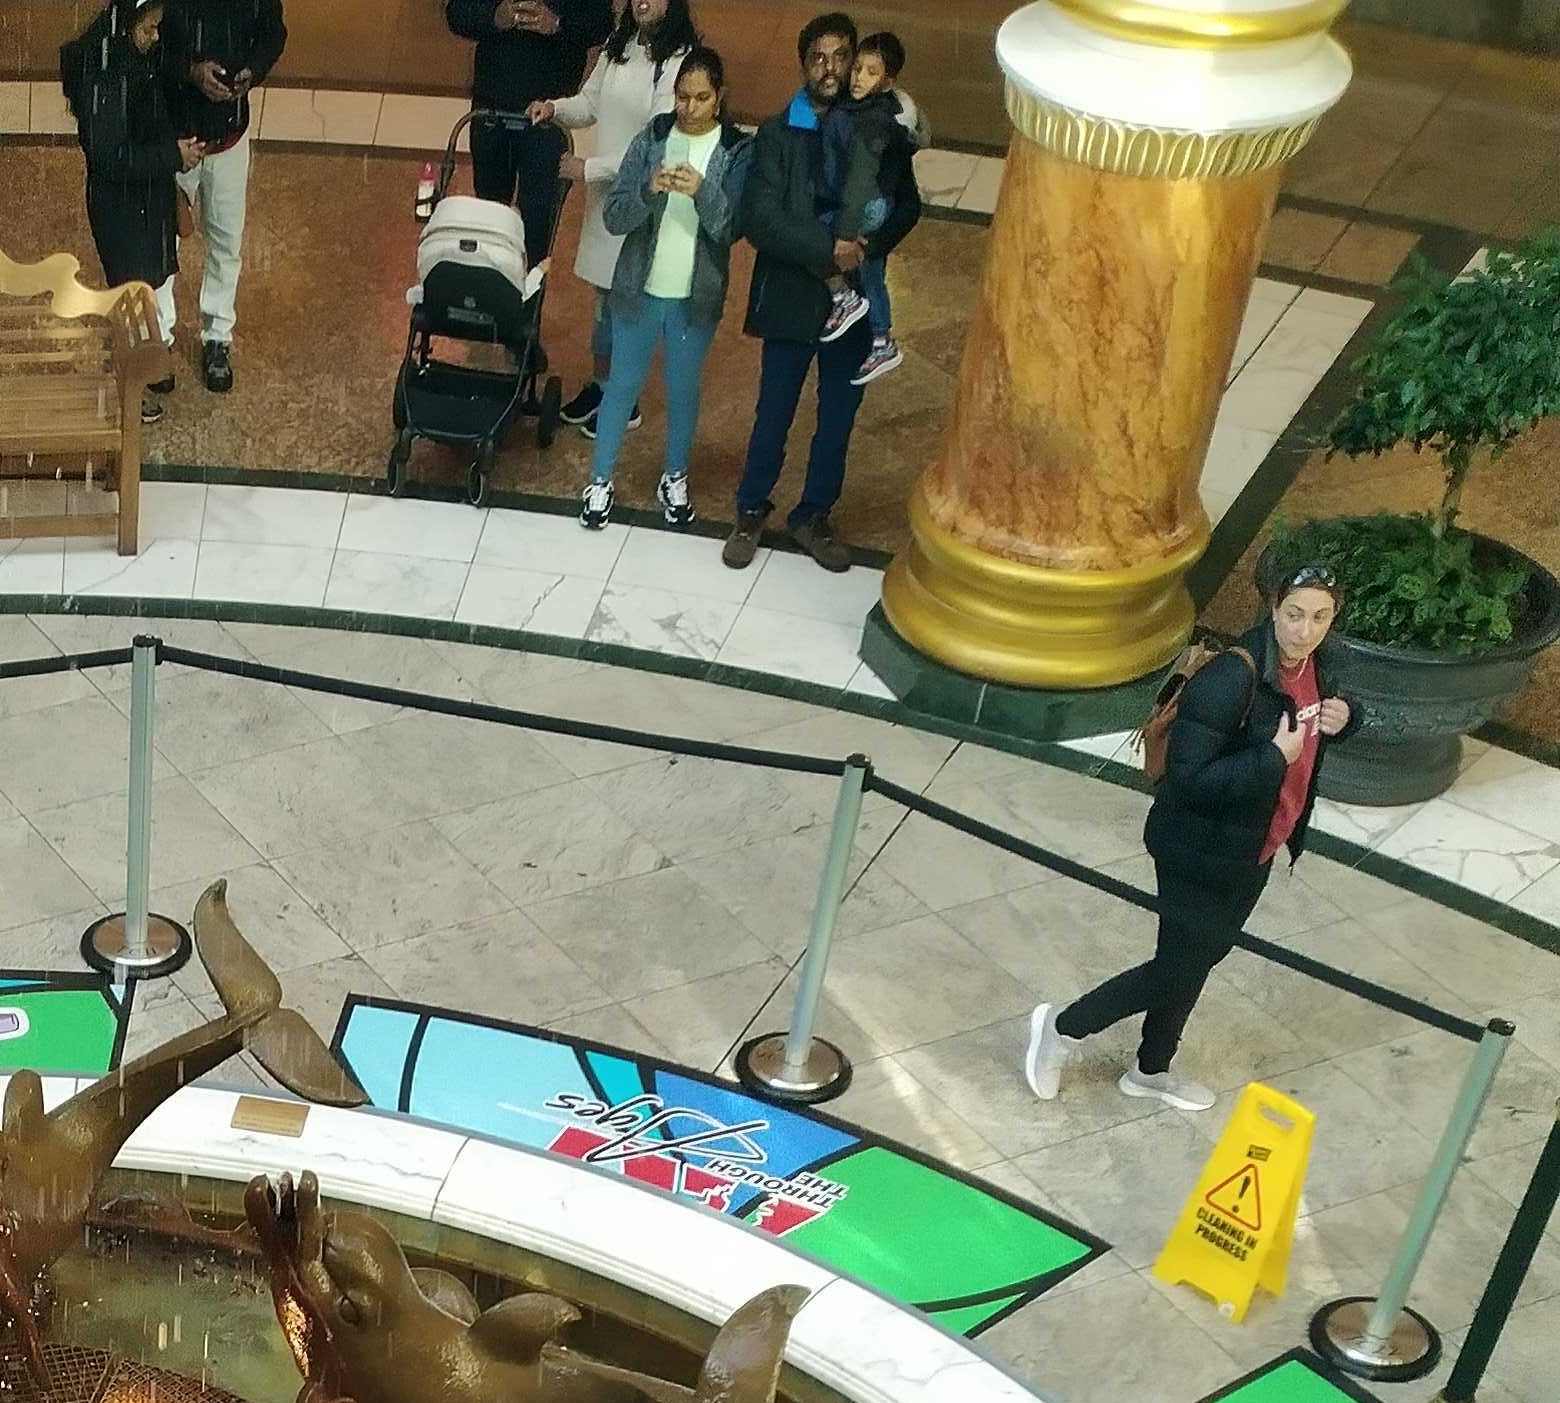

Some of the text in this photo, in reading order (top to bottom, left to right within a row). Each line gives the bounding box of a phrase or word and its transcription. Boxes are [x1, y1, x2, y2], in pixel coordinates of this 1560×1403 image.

[545, 1094, 769, 1164] Ages
[707, 1158, 834, 1208] THROUGH
[796, 1172, 849, 1200] THE
[1195, 1224, 1248, 1262] PROGRESS
[1196, 1206, 1244, 1243] CLEANING
